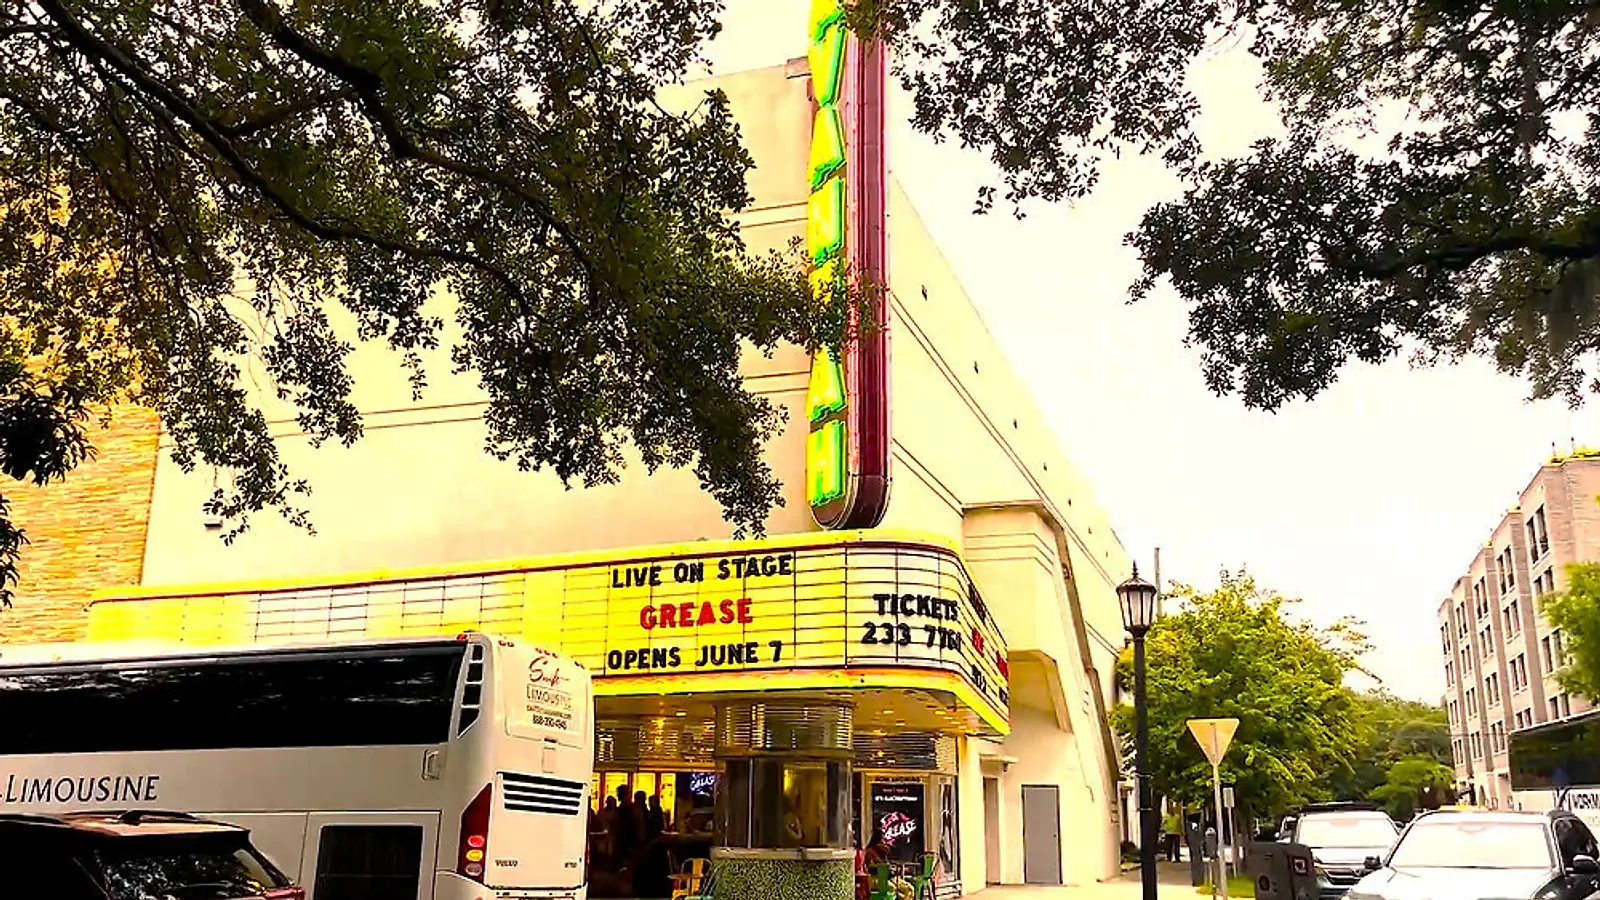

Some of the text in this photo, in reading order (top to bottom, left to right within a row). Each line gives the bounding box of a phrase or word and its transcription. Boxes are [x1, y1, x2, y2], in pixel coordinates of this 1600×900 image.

[611, 554, 792, 588] LIVE ON STAGE
[639, 597, 753, 631] GREASE
[872, 593, 958, 621] TICKETS
[860, 621, 911, 645] 233
[607, 640, 783, 670] OPENS JUNE 7
[5, 774, 160, 803] LIMOUSINE
